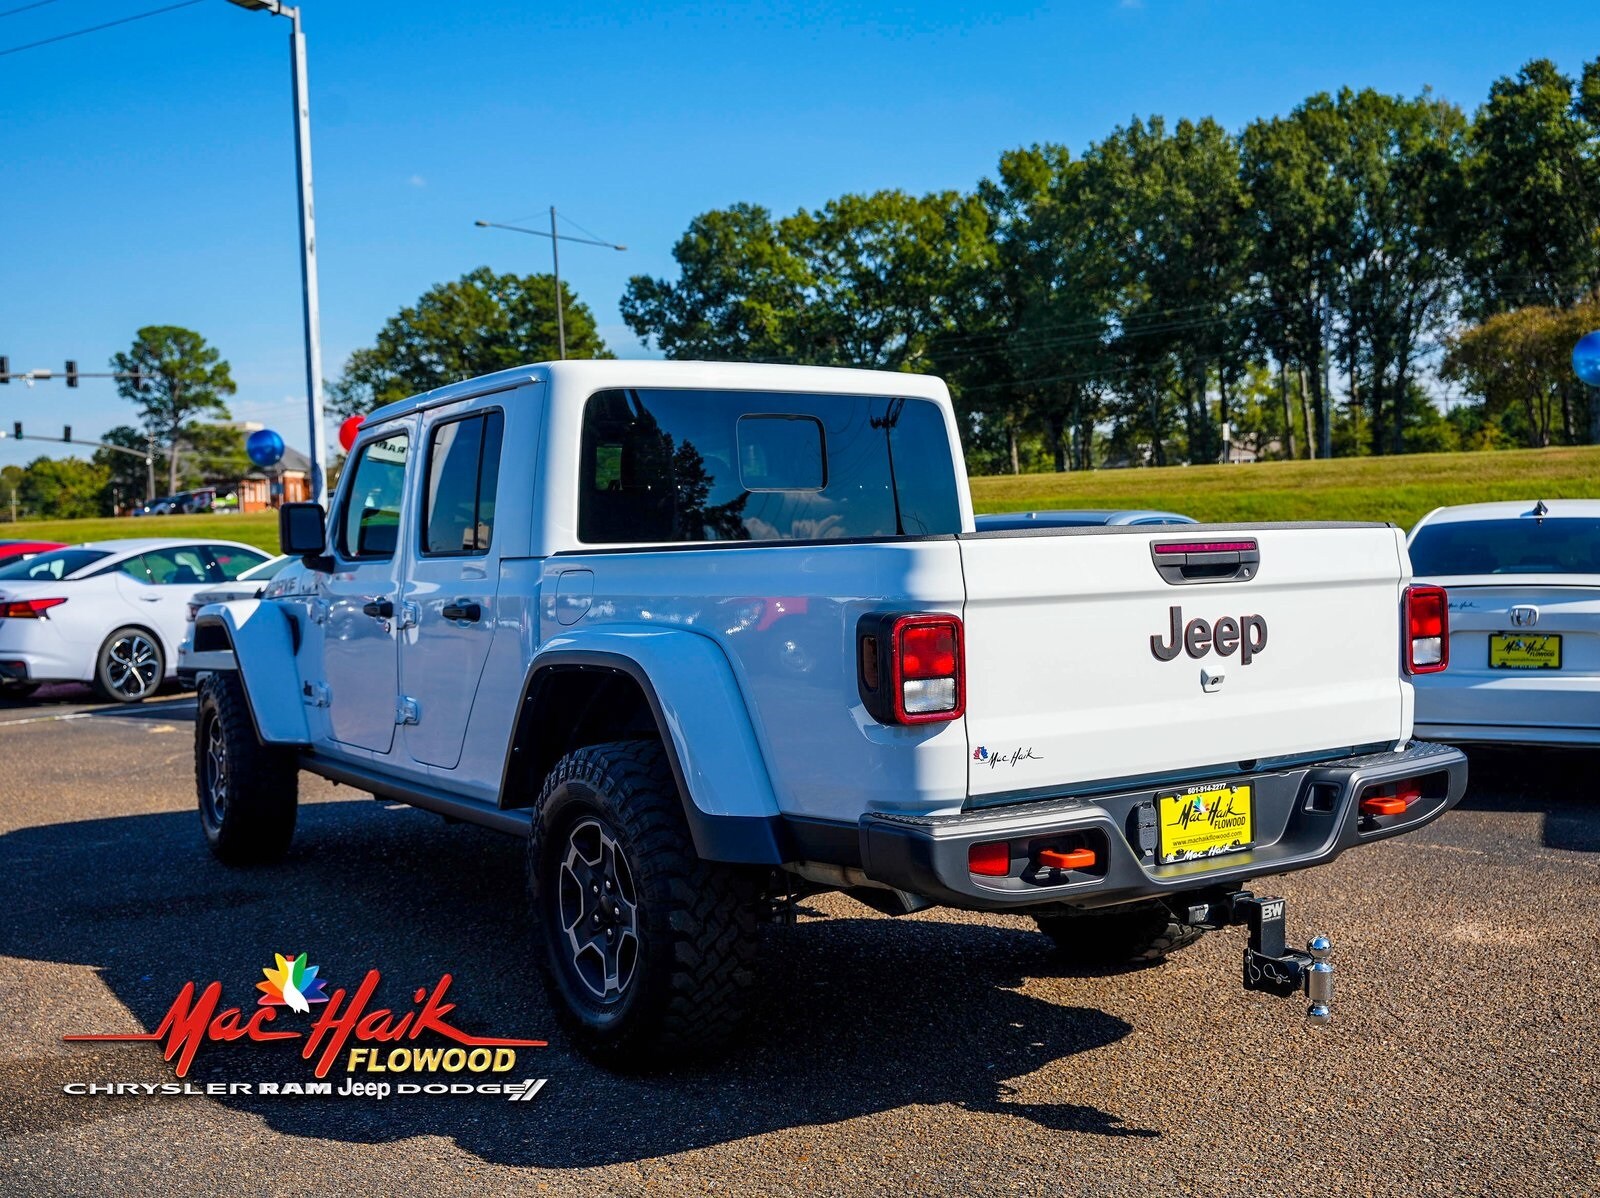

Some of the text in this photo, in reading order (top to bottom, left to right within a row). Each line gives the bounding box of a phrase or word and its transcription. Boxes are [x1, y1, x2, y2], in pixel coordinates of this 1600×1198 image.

[1150, 605, 1268, 666] Jeep
[985, 747, 1044, 769] Mac Haik
[1187, 783, 1227, 795] 601-914-2277
[1168, 796, 1246, 830] Mac Haik
[1213, 816, 1246, 830] FLOWOOD
[1172, 831, 1242, 847] www.machaikflowood.com
